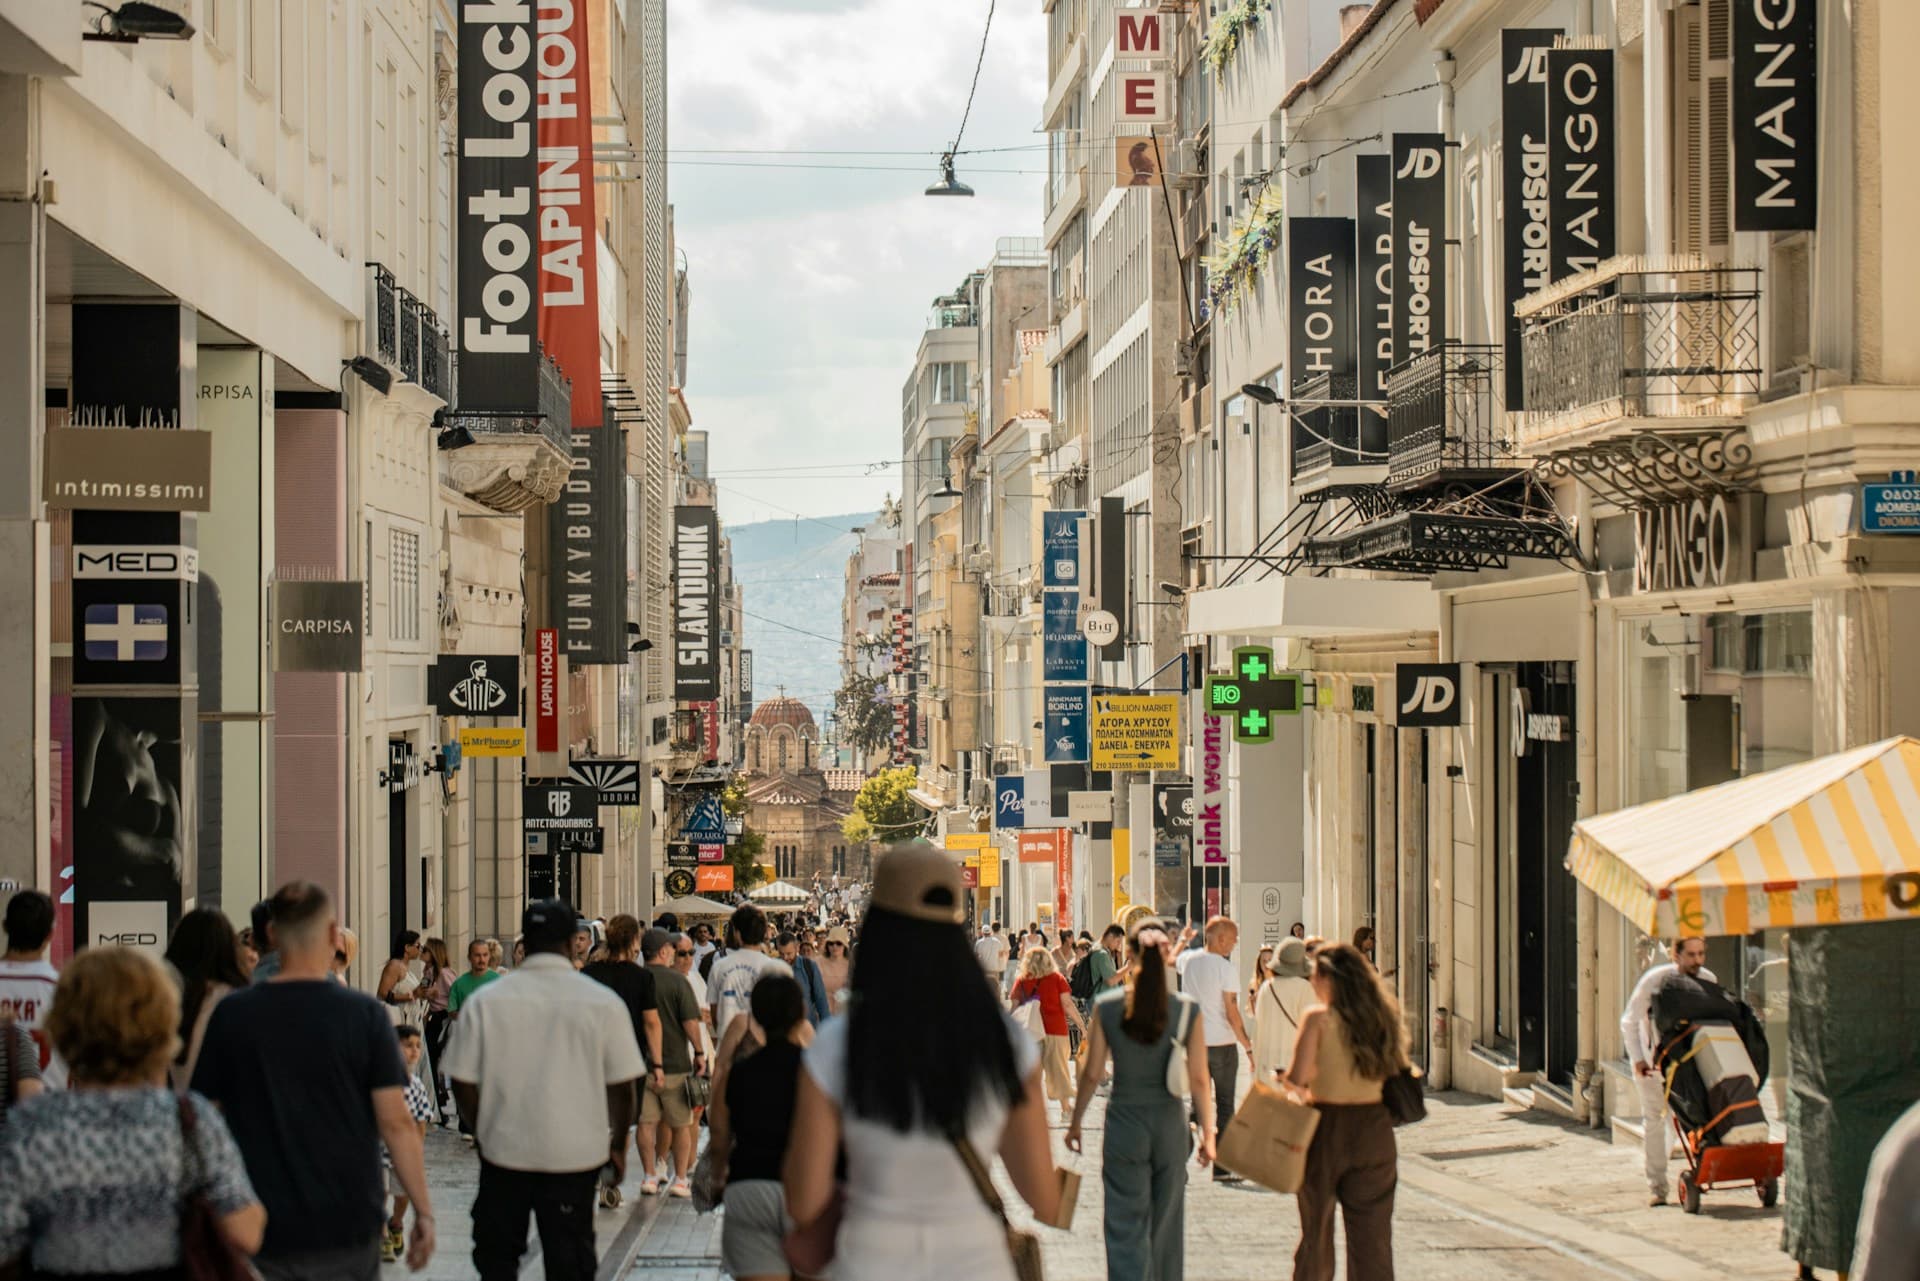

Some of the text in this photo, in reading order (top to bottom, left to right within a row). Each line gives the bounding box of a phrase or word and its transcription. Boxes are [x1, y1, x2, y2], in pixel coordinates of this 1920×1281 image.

[1397, 148, 1442, 180] JD
[537, 145, 585, 306] LAPIN
[464, 186, 530, 353] Foot
[56, 479, 204, 499] intimissimi
[78, 552, 178, 572] MED
[281, 619, 353, 633] CARPISA
[541, 632, 553, 717] LAPIN HOUSE
[1402, 676, 1455, 714] JD
[1142, 704, 1173, 712] MARKET
[1100, 718, 1170, 727] ΑΓΟΡΑ ΧΡΥΣΟΥ
[1134, 741, 1170, 749] ΕΝΕΧΥΡΑ
[1197, 804, 1227, 863] pink
[99, 933, 157, 945] MED
